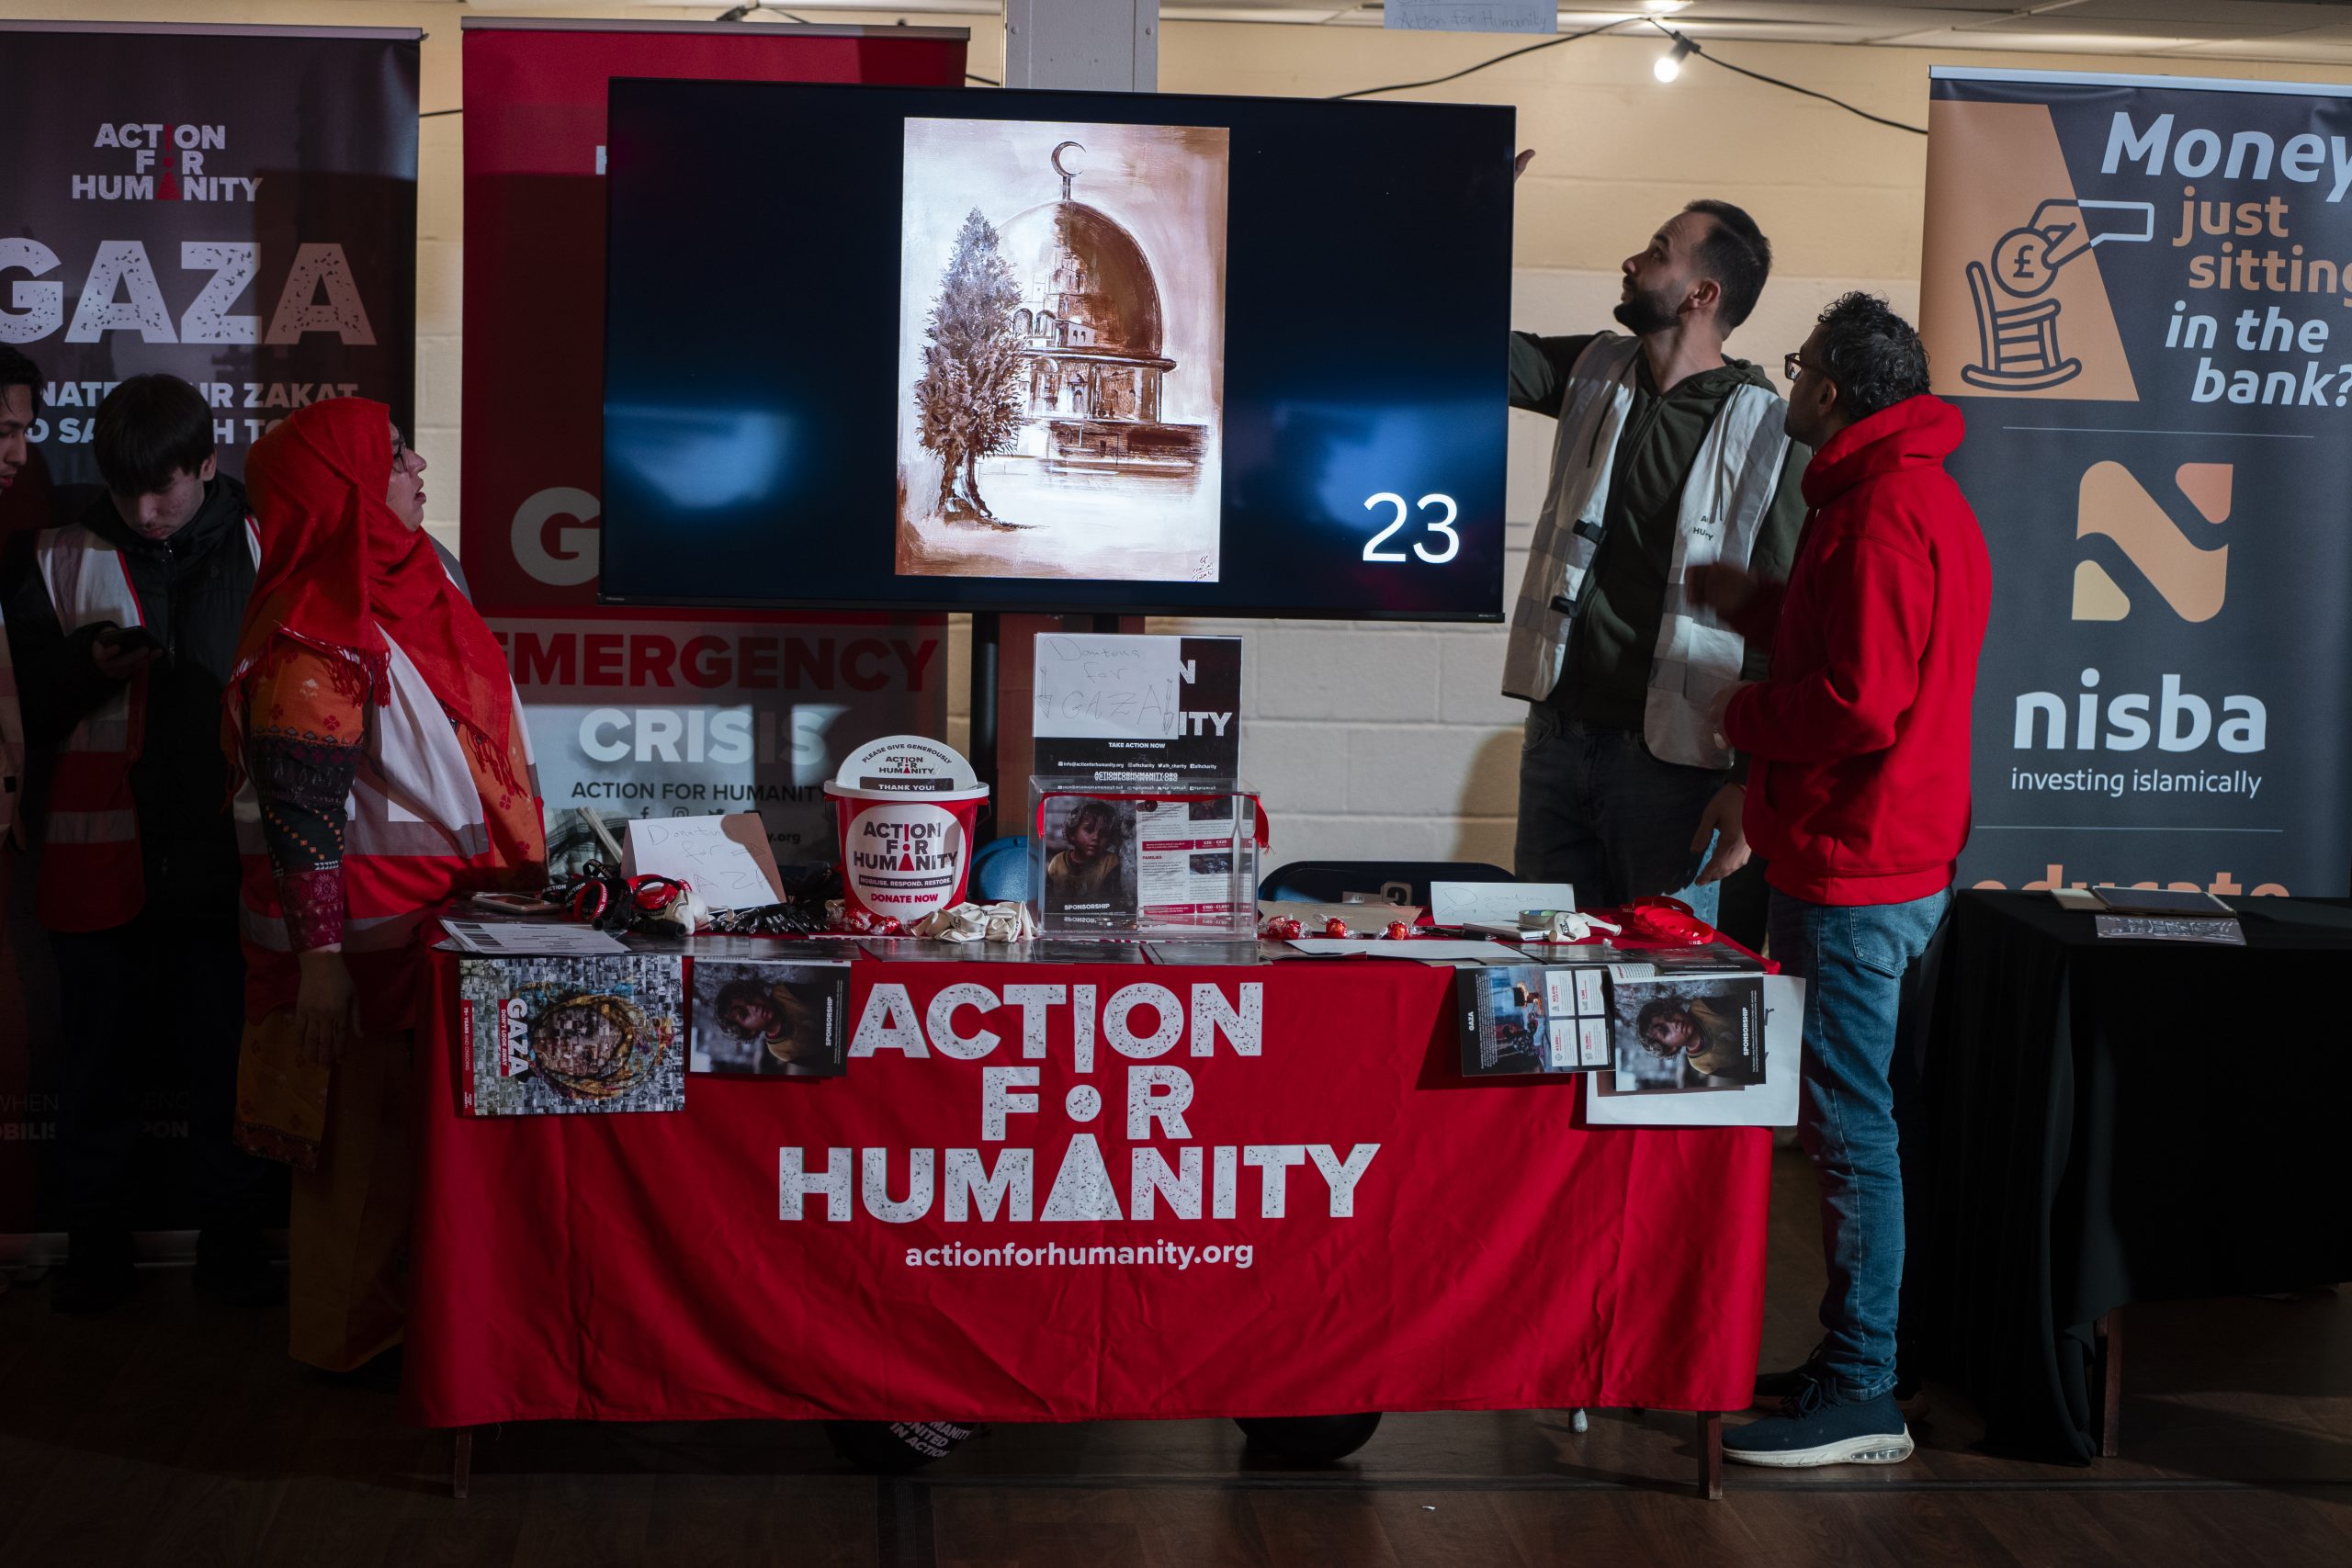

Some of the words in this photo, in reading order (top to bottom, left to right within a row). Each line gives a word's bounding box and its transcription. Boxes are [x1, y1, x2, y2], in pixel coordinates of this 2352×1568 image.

[94, 123, 226, 150] ACTION
[2101, 111, 2352, 203] Money
[72, 172, 263, 202] HUMANITY
[2172, 186, 2289, 246] just
[0, 237, 377, 345] GAZA
[2165, 300, 2219, 349] in
[2235, 306, 2330, 354] the
[243, 382, 358, 408] ZAKAT
[2191, 357, 2352, 408] bank?
[1363, 492, 1459, 563] 23
[492, 632, 939, 692] MERGENCY
[1061, 684, 1162, 727] GAZA
[2013, 668, 2267, 753] nisba
[579, 707, 827, 764] CRISIS
[862, 746, 887, 764] PLEASE
[887, 743, 905, 751] GIVE
[907, 743, 953, 765] GENEROUSLY
[885, 756, 923, 764] ACTION
[571, 782, 654, 801] ACTION
[662, 783, 707, 801] FOR
[713, 784, 826, 802] HUMANITY
[2011, 768, 2125, 798] investing
[2132, 769, 2263, 800] islamically
[863, 821, 941, 840] ACTION
[854, 851, 958, 872] HUMANITY
[871, 894, 911, 903] DONATE
[914, 894, 938, 903] NOW
[890, 879, 923, 887] RESPOND.
[924, 877, 952, 886] RESTORE.
[1064, 902, 1111, 910] SPONSORSHIP
[507, 998, 528, 1077] GAZA
[847, 982, 1263, 1073] ACTION
[779, 1134, 1381, 1223] HUMANITY
[905, 1240, 1253, 1270] actionforhumanity.org
[888, 1422, 910, 1438] IN
[904, 1436, 952, 1458] ACTION
